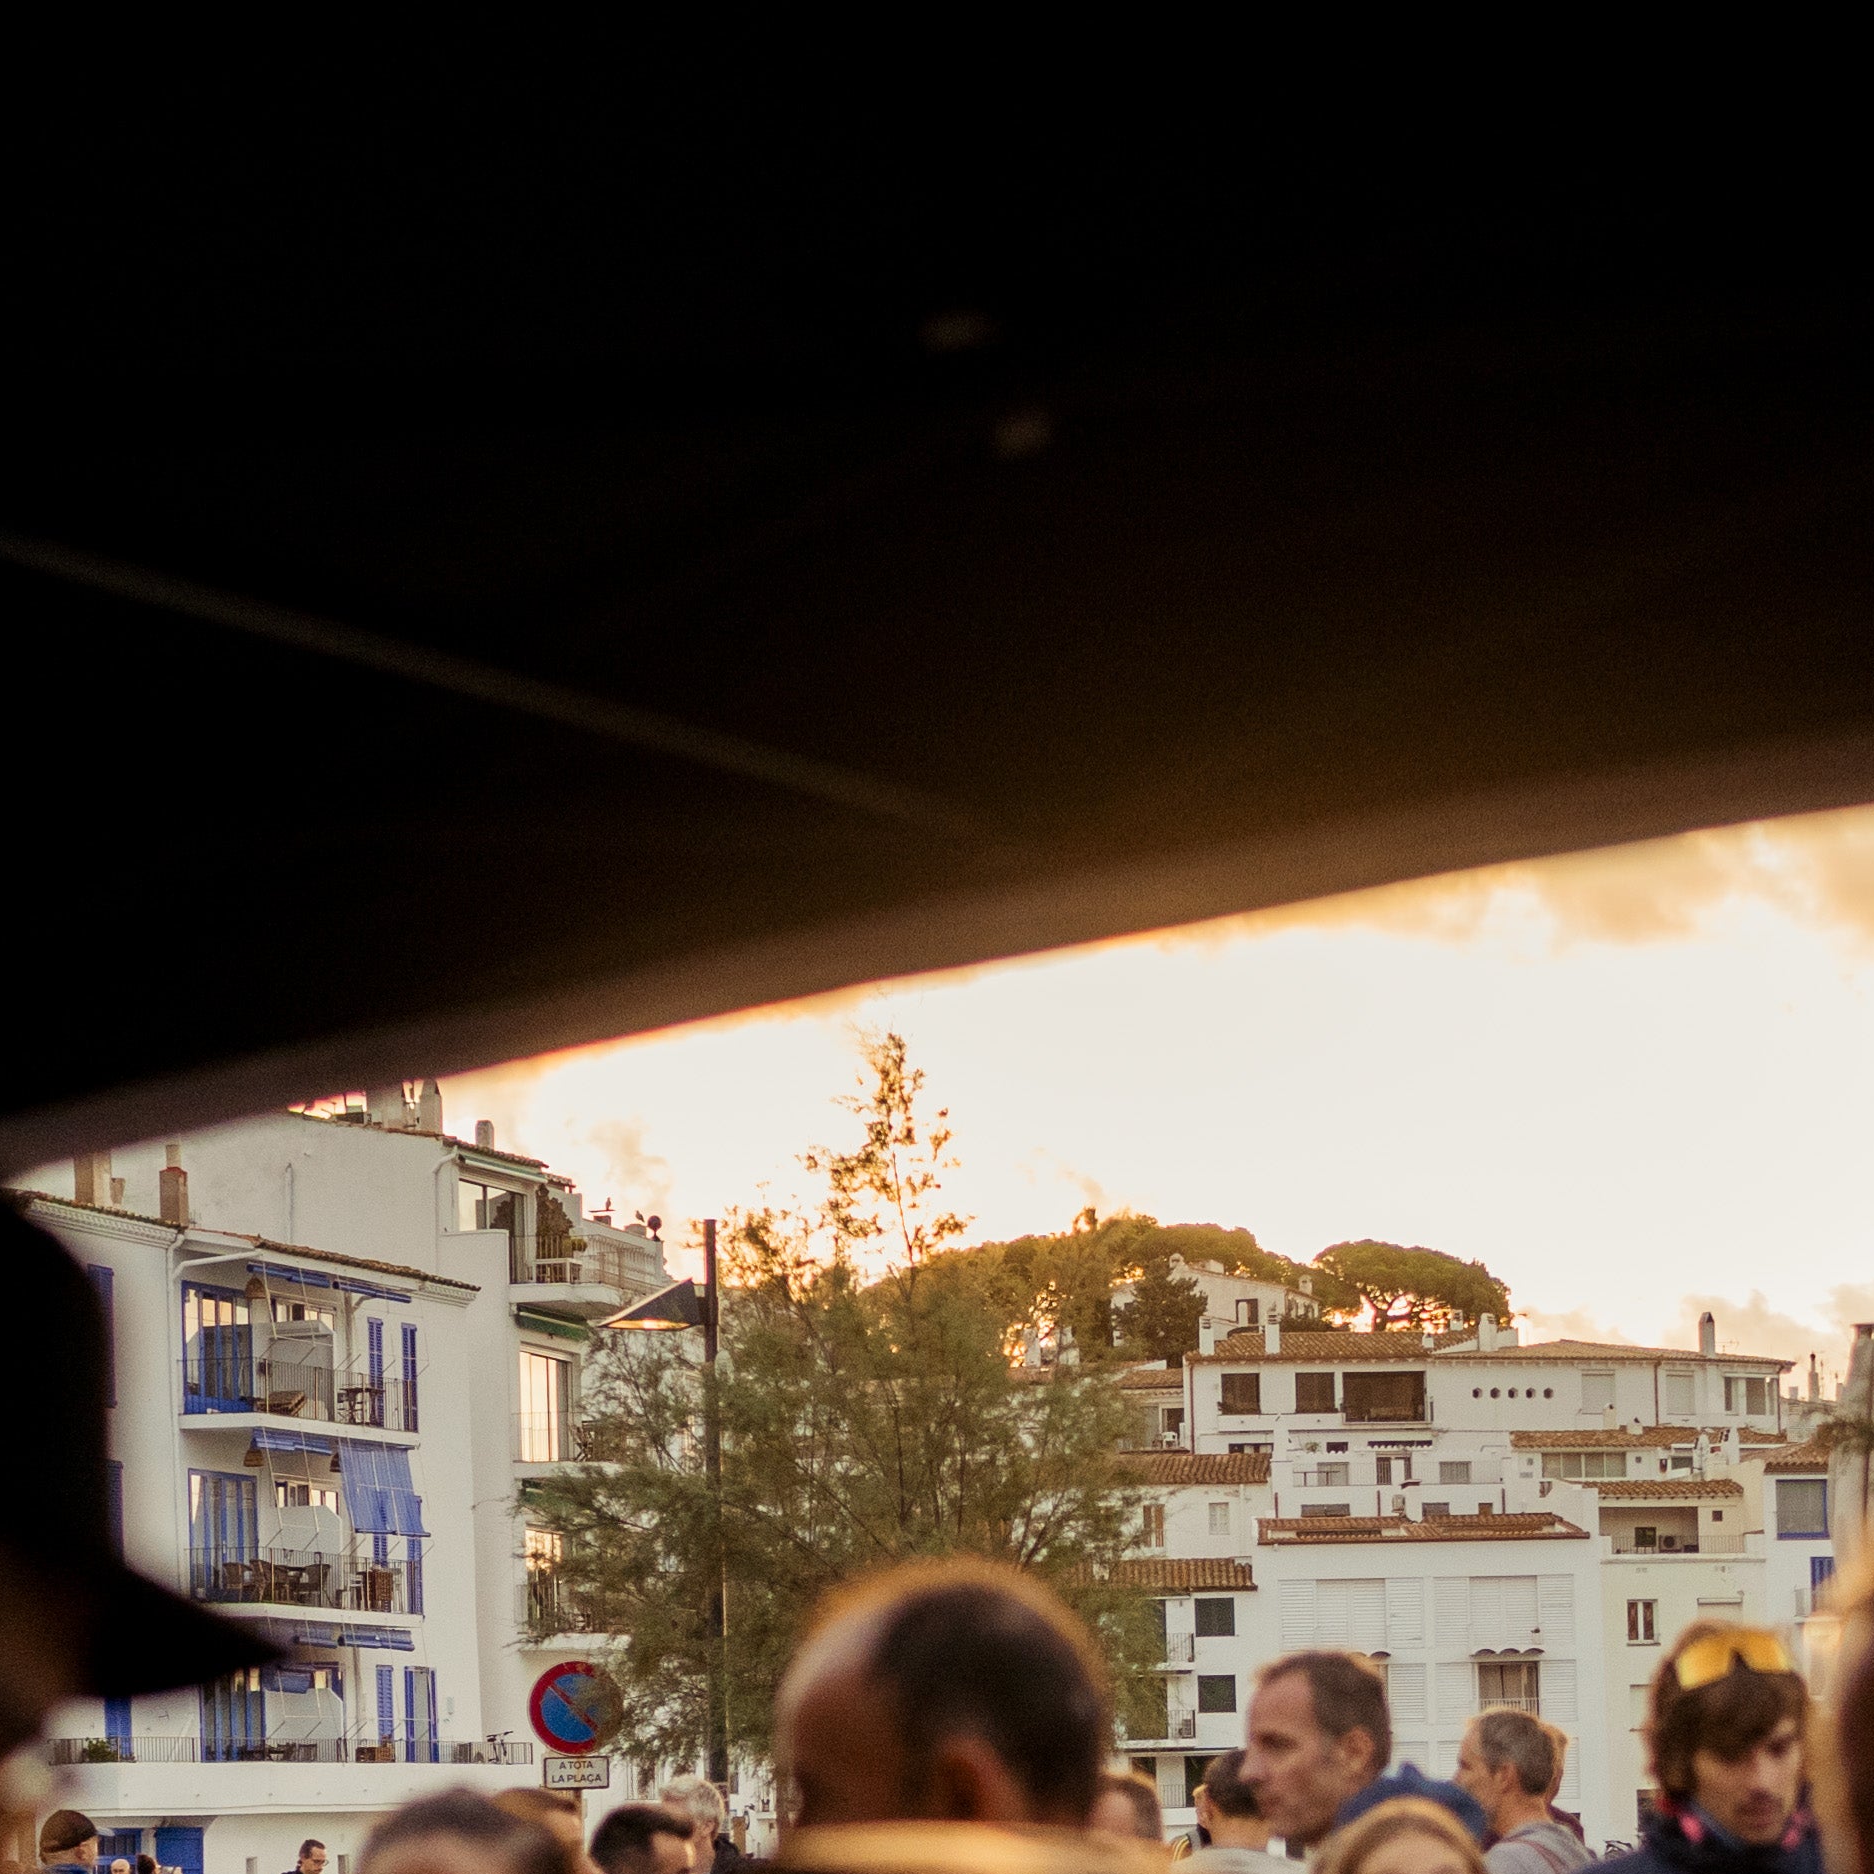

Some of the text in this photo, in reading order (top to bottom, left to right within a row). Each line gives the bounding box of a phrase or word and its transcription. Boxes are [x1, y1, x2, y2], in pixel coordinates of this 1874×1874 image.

[559, 1761, 593, 1769] A TOTA
[552, 1775, 564, 1783] LA
